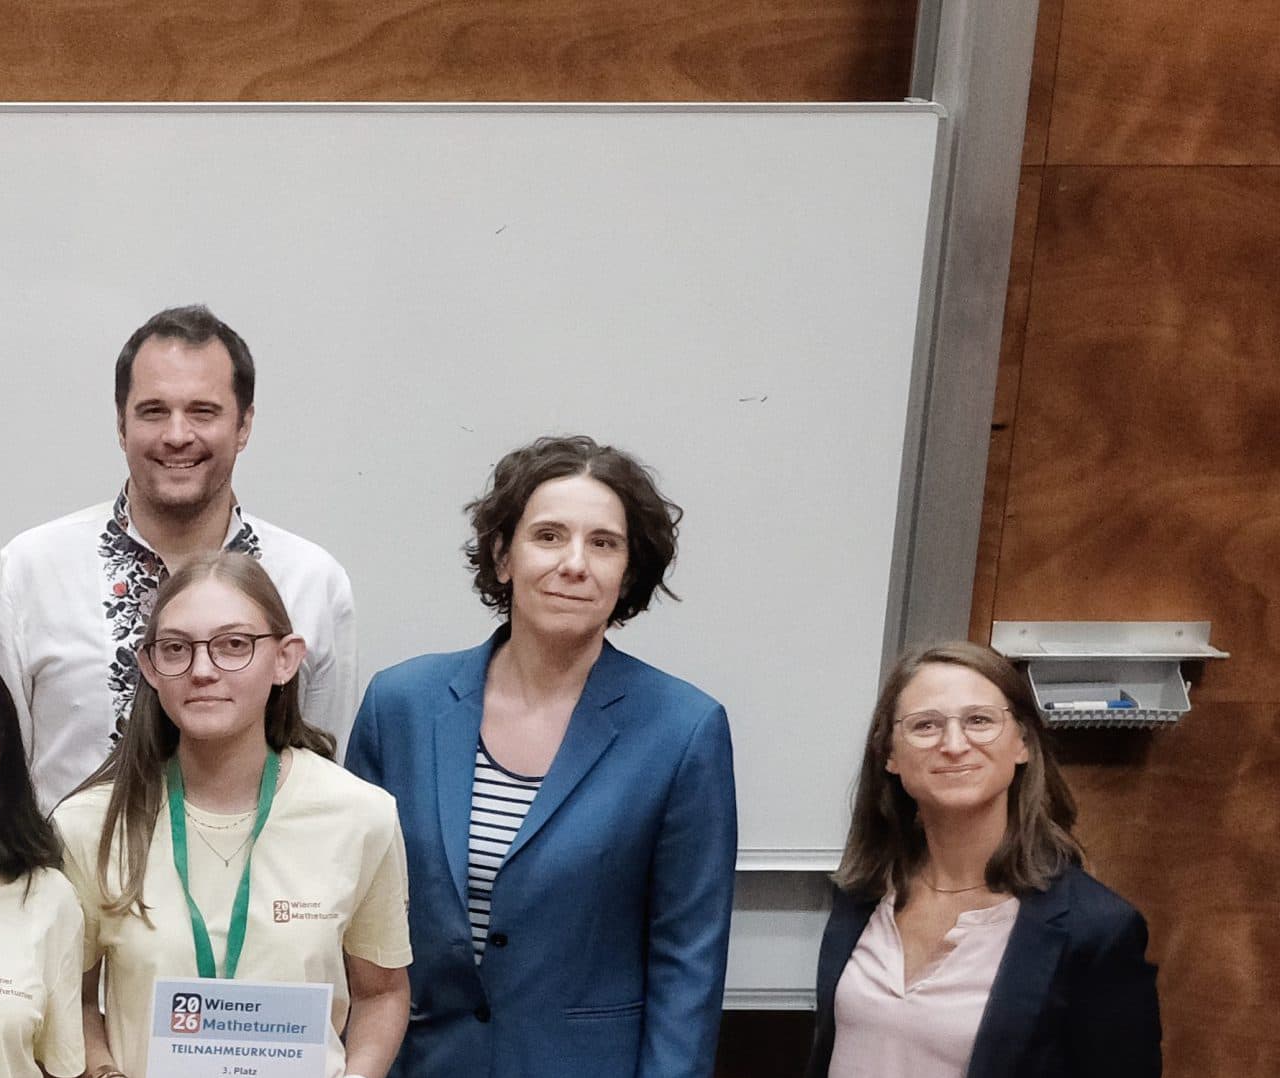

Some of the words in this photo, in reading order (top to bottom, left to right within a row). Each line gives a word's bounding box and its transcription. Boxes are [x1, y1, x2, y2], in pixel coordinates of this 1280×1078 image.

[174, 997, 200, 1013] 20
[205, 998, 261, 1012] Wiener
[173, 1013, 199, 1030] 26
[203, 1019, 307, 1034] Matheturnier
[171, 1044, 303, 1058] TEILNAHMEURKUNDE
[234, 1067, 257, 1075] Platz
